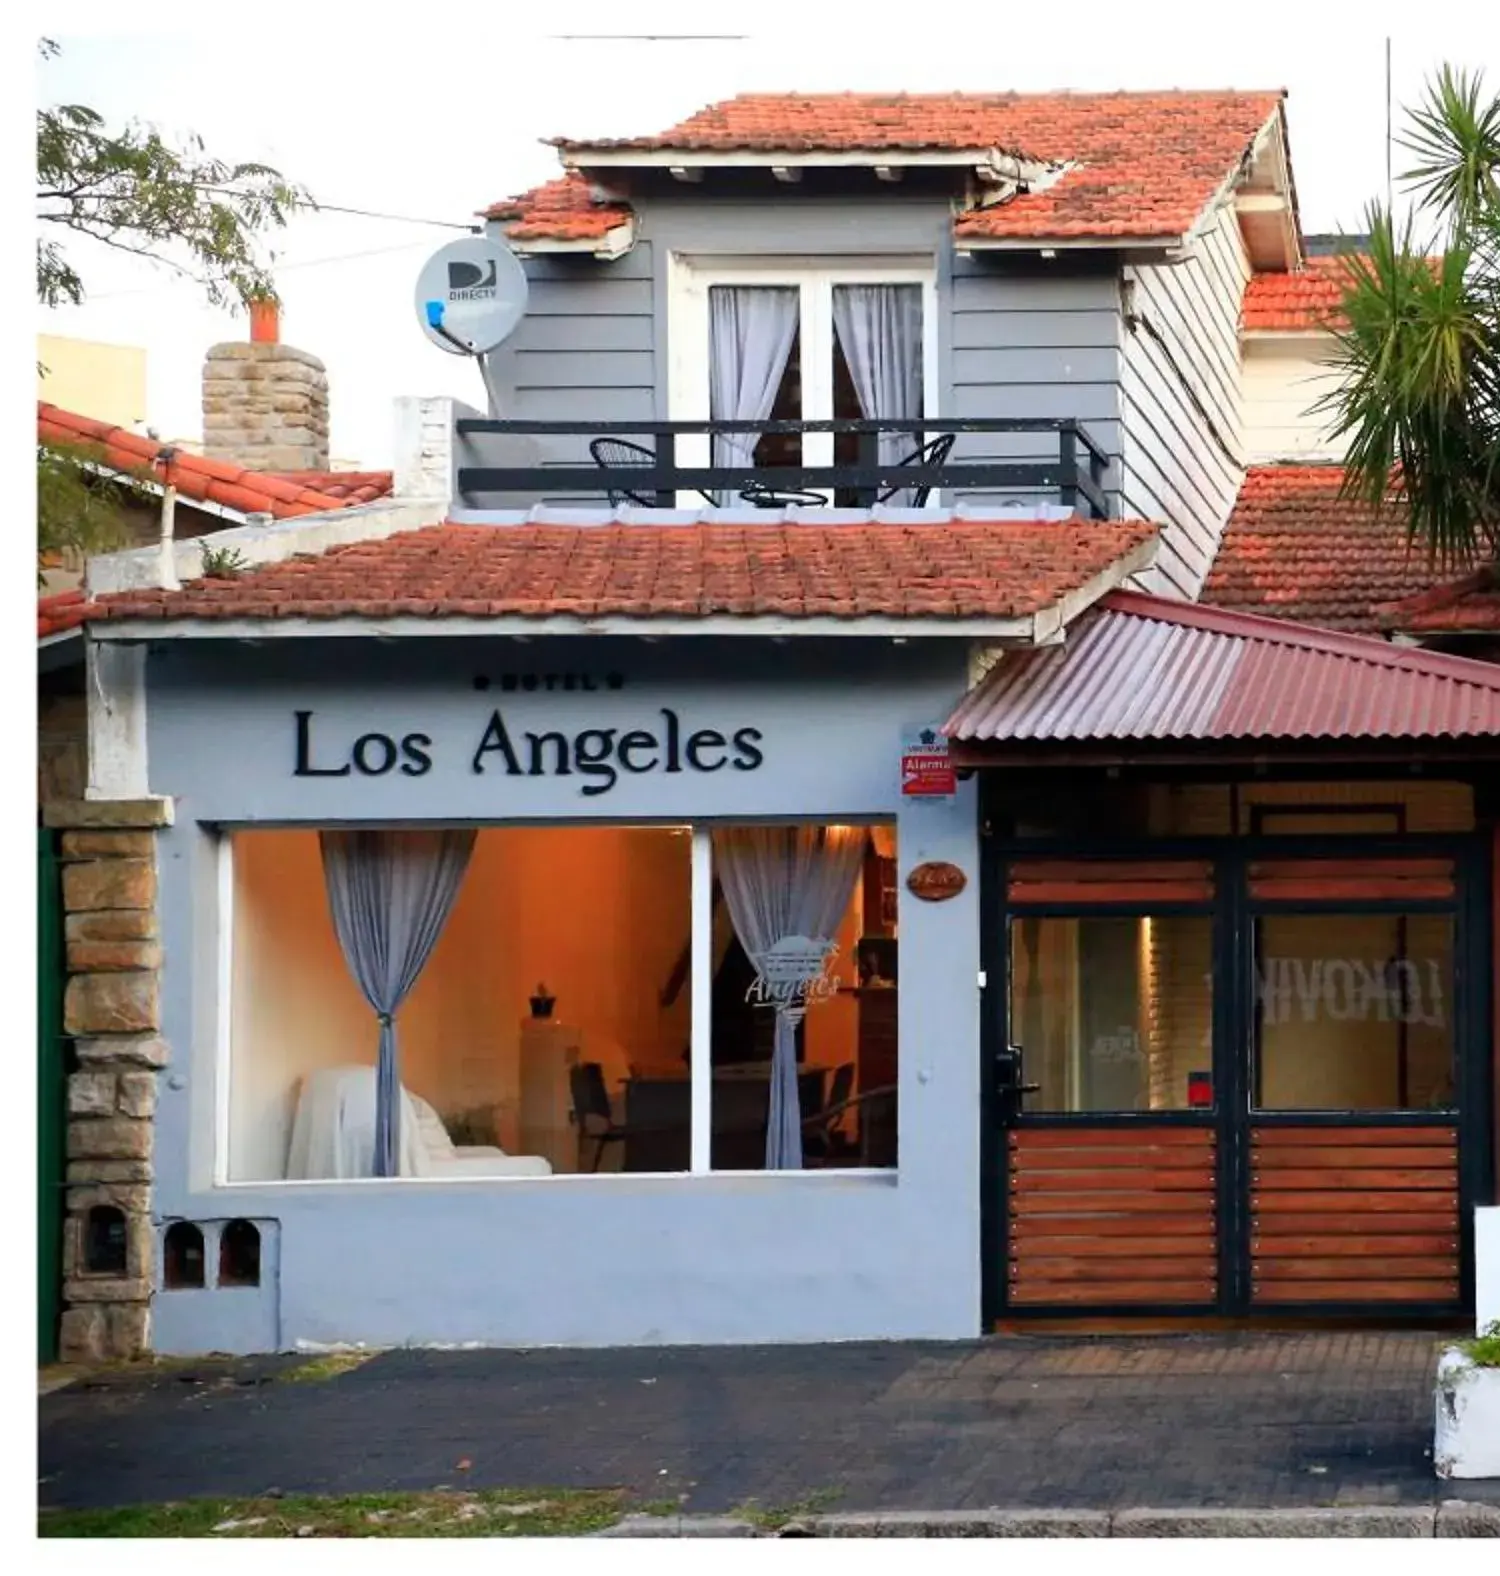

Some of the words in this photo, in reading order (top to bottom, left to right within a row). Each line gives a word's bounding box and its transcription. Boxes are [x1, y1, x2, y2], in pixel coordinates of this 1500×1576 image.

[449, 288, 497, 301] DIRECTV
[501, 672, 598, 692] HOTEL
[293, 709, 433, 777] Los
[472, 707, 764, 797] Angeles
